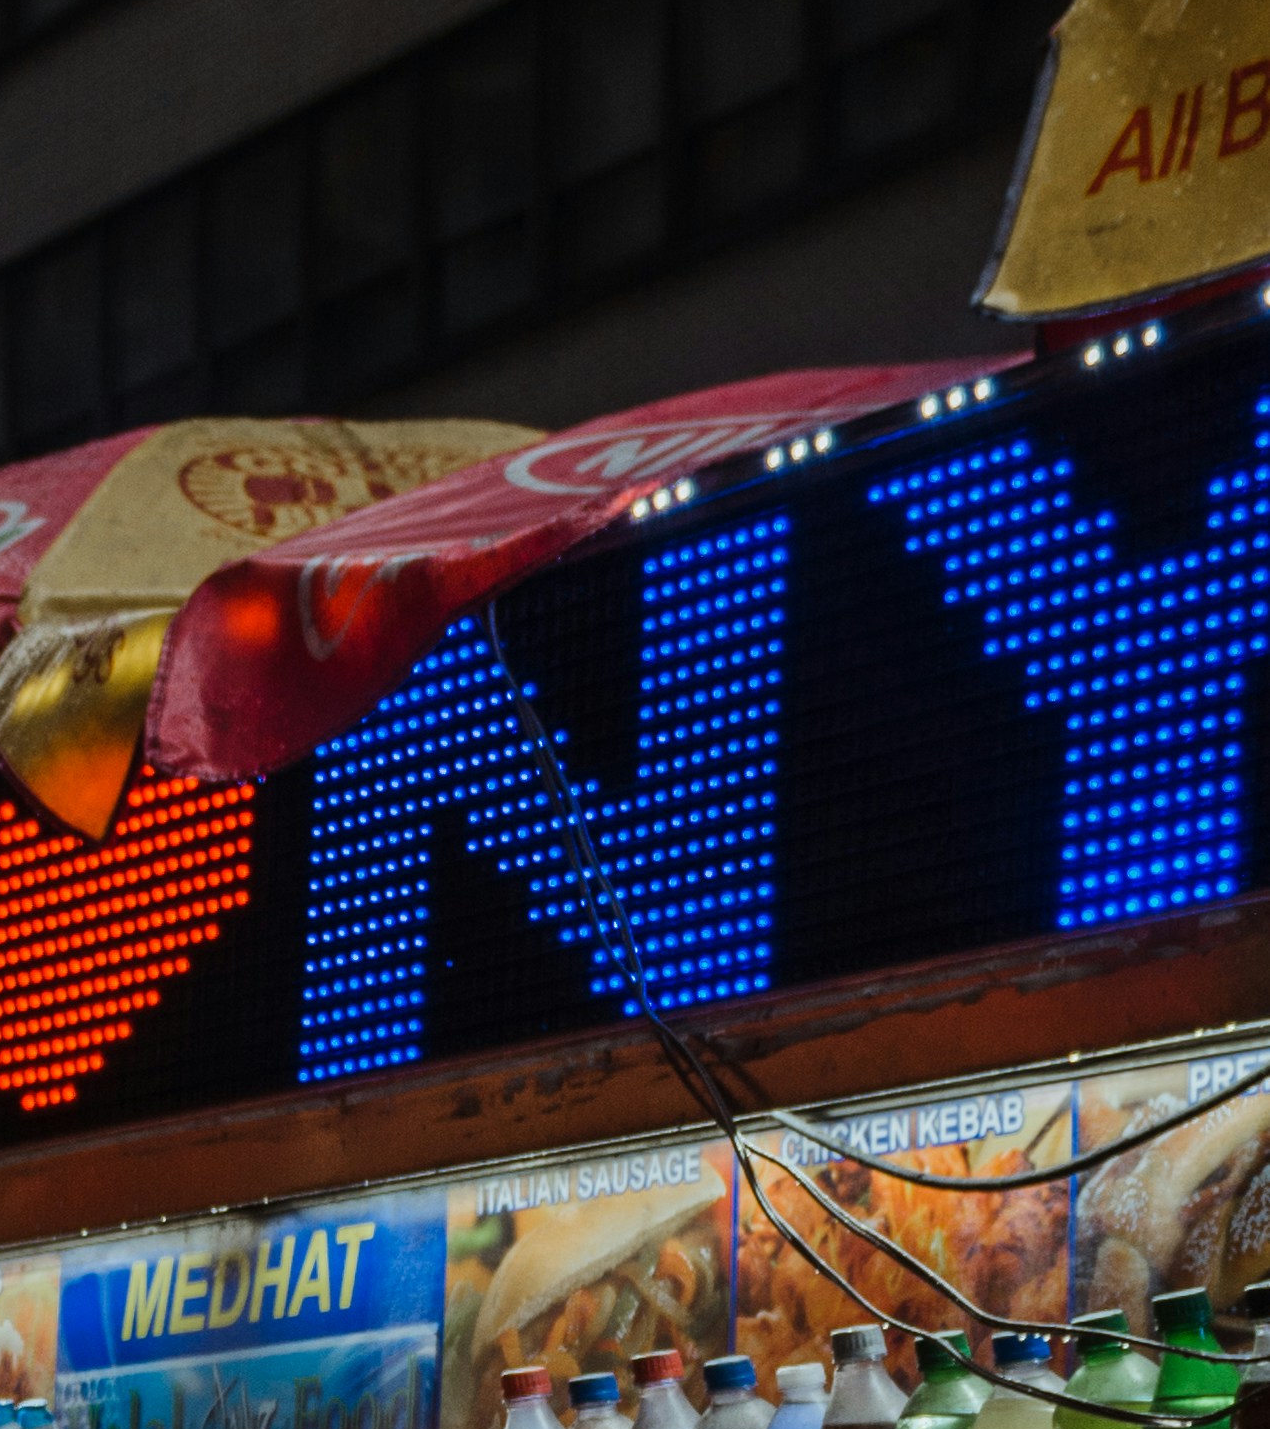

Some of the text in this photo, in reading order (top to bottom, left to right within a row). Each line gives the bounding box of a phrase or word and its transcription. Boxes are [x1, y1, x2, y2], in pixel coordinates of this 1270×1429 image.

[1084, 84, 1205, 198] All
[781, 1092, 1025, 1167] CHICKEN KEBAB
[476, 1148, 702, 1217] ITALIAN SAUSAGE
[121, 1222, 376, 1342] MEDHAT
